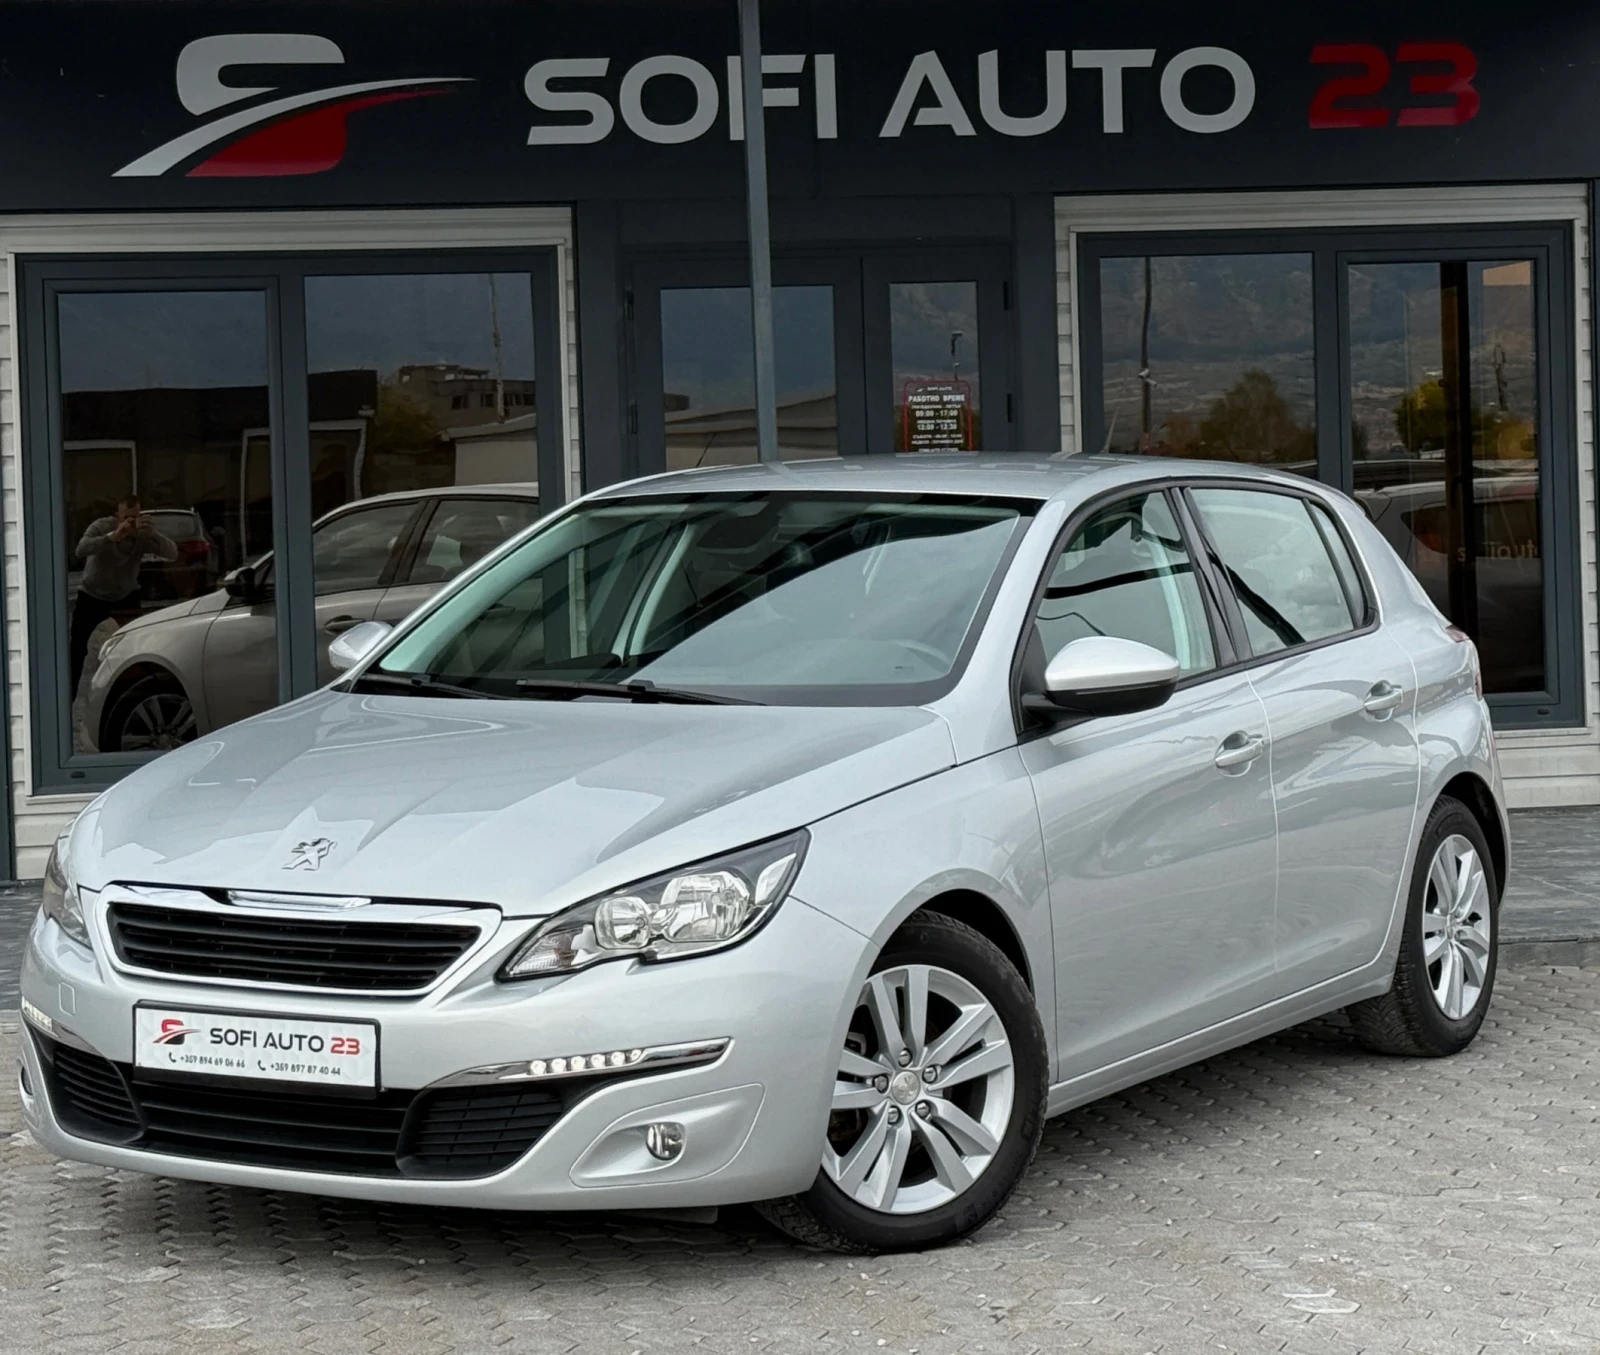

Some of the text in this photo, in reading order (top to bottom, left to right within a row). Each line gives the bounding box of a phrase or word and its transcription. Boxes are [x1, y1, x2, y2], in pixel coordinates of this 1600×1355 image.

[524, 41, 1480, 145] SOFI AUTO 23
[209, 1027, 361, 1055] SOFI AUTO 23
[180, 1054, 198, 1063] +359
[199, 1055, 213, 1064] 894
[214, 1057, 224, 1066] 69
[225, 1058, 234, 1067] 06
[270, 1062, 341, 1076] +359 897 87 40 44
